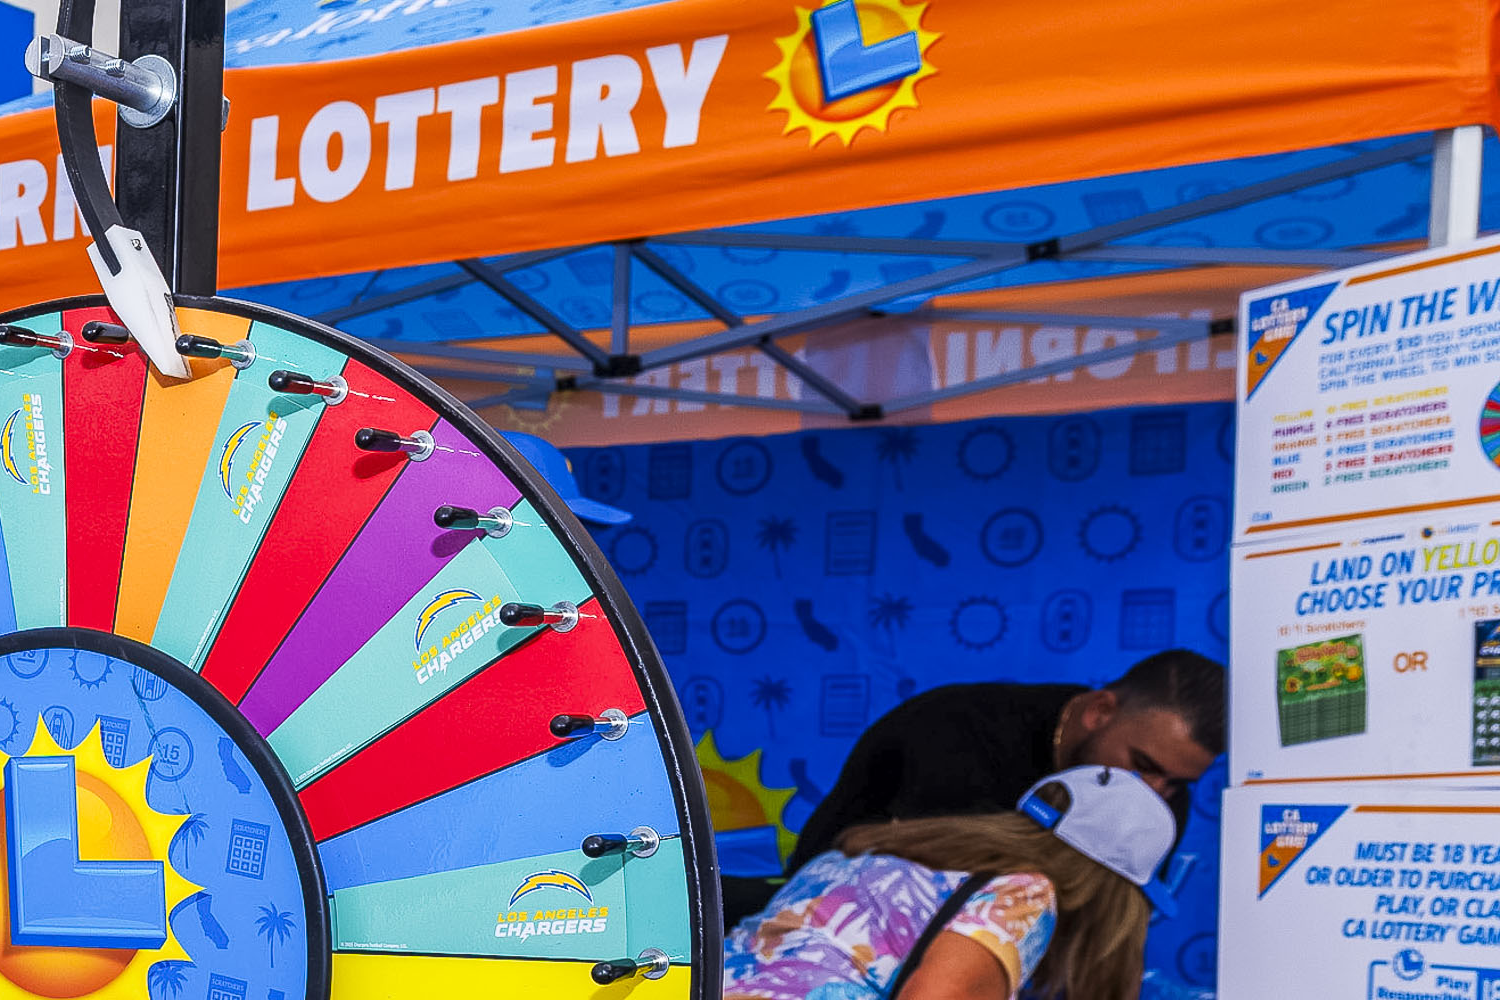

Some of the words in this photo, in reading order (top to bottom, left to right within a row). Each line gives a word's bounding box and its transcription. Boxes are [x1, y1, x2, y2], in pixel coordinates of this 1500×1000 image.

[246, 34, 729, 212] LOTTERY
[1321, 301, 1391, 346] SPIN
[1400, 287, 1458, 330] THE
[30, 393, 53, 495] CHARGERS
[232, 485, 249, 516] LOS
[246, 410, 278, 482] ANGELES
[239, 416, 288, 525] CHARGERS
[1310, 555, 1373, 586] LAND
[1380, 550, 1416, 576] ON
[1422, 539, 1500, 572] YELLO
[1295, 583, 1389, 617] CHOOSE
[1398, 575, 1463, 606] YOUR
[412, 645, 438, 671] LOS
[442, 594, 502, 648] ANGELES
[1393, 651, 1429, 673] OR
[1355, 842, 1408, 862] MUST
[1411, 843, 1435, 863] BE
[1442, 844, 1466, 864] 18
[1305, 866, 1332, 885] OR
[1334, 868, 1395, 888] OLDER
[1400, 869, 1423, 888] TO
[497, 911, 528, 923] LOS
[533, 907, 609, 921] ANGELES
[1374, 894, 1425, 918] PLAY,
[1430, 897, 1459, 916] OR
[494, 918, 607, 944] CHARGERS
[1342, 919, 1366, 938] CA
[1458, 924, 1500, 945] GAM
[1436, 975, 1470, 992] Play
